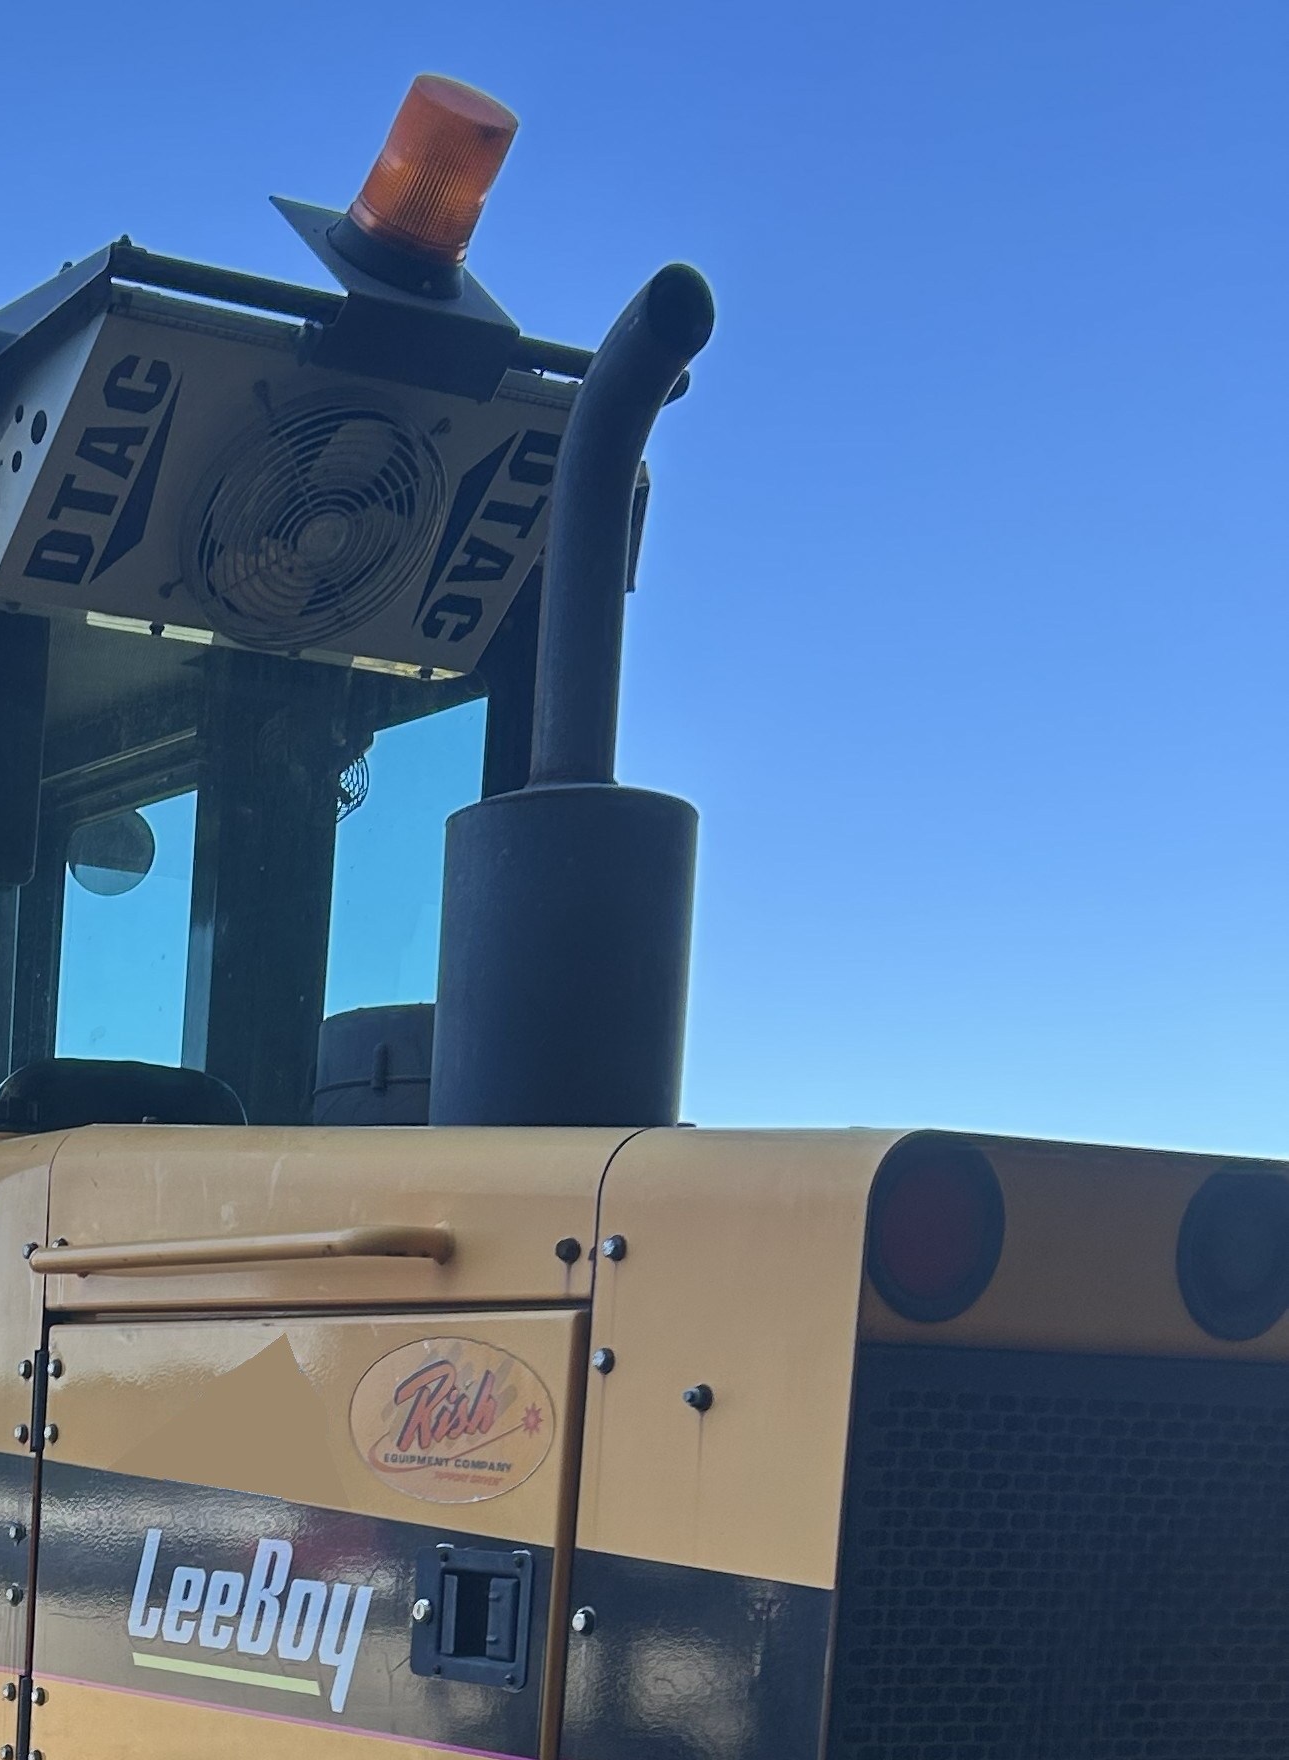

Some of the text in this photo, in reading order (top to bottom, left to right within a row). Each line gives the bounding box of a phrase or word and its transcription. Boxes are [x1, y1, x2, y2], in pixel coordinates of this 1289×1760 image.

[22, 354, 172, 584] DTAC
[383, 1452, 512, 1472] EQUIPMENT COMPANY
[394, 1359, 498, 1452] Rish
[127, 1528, 374, 1714] LeeBoy
